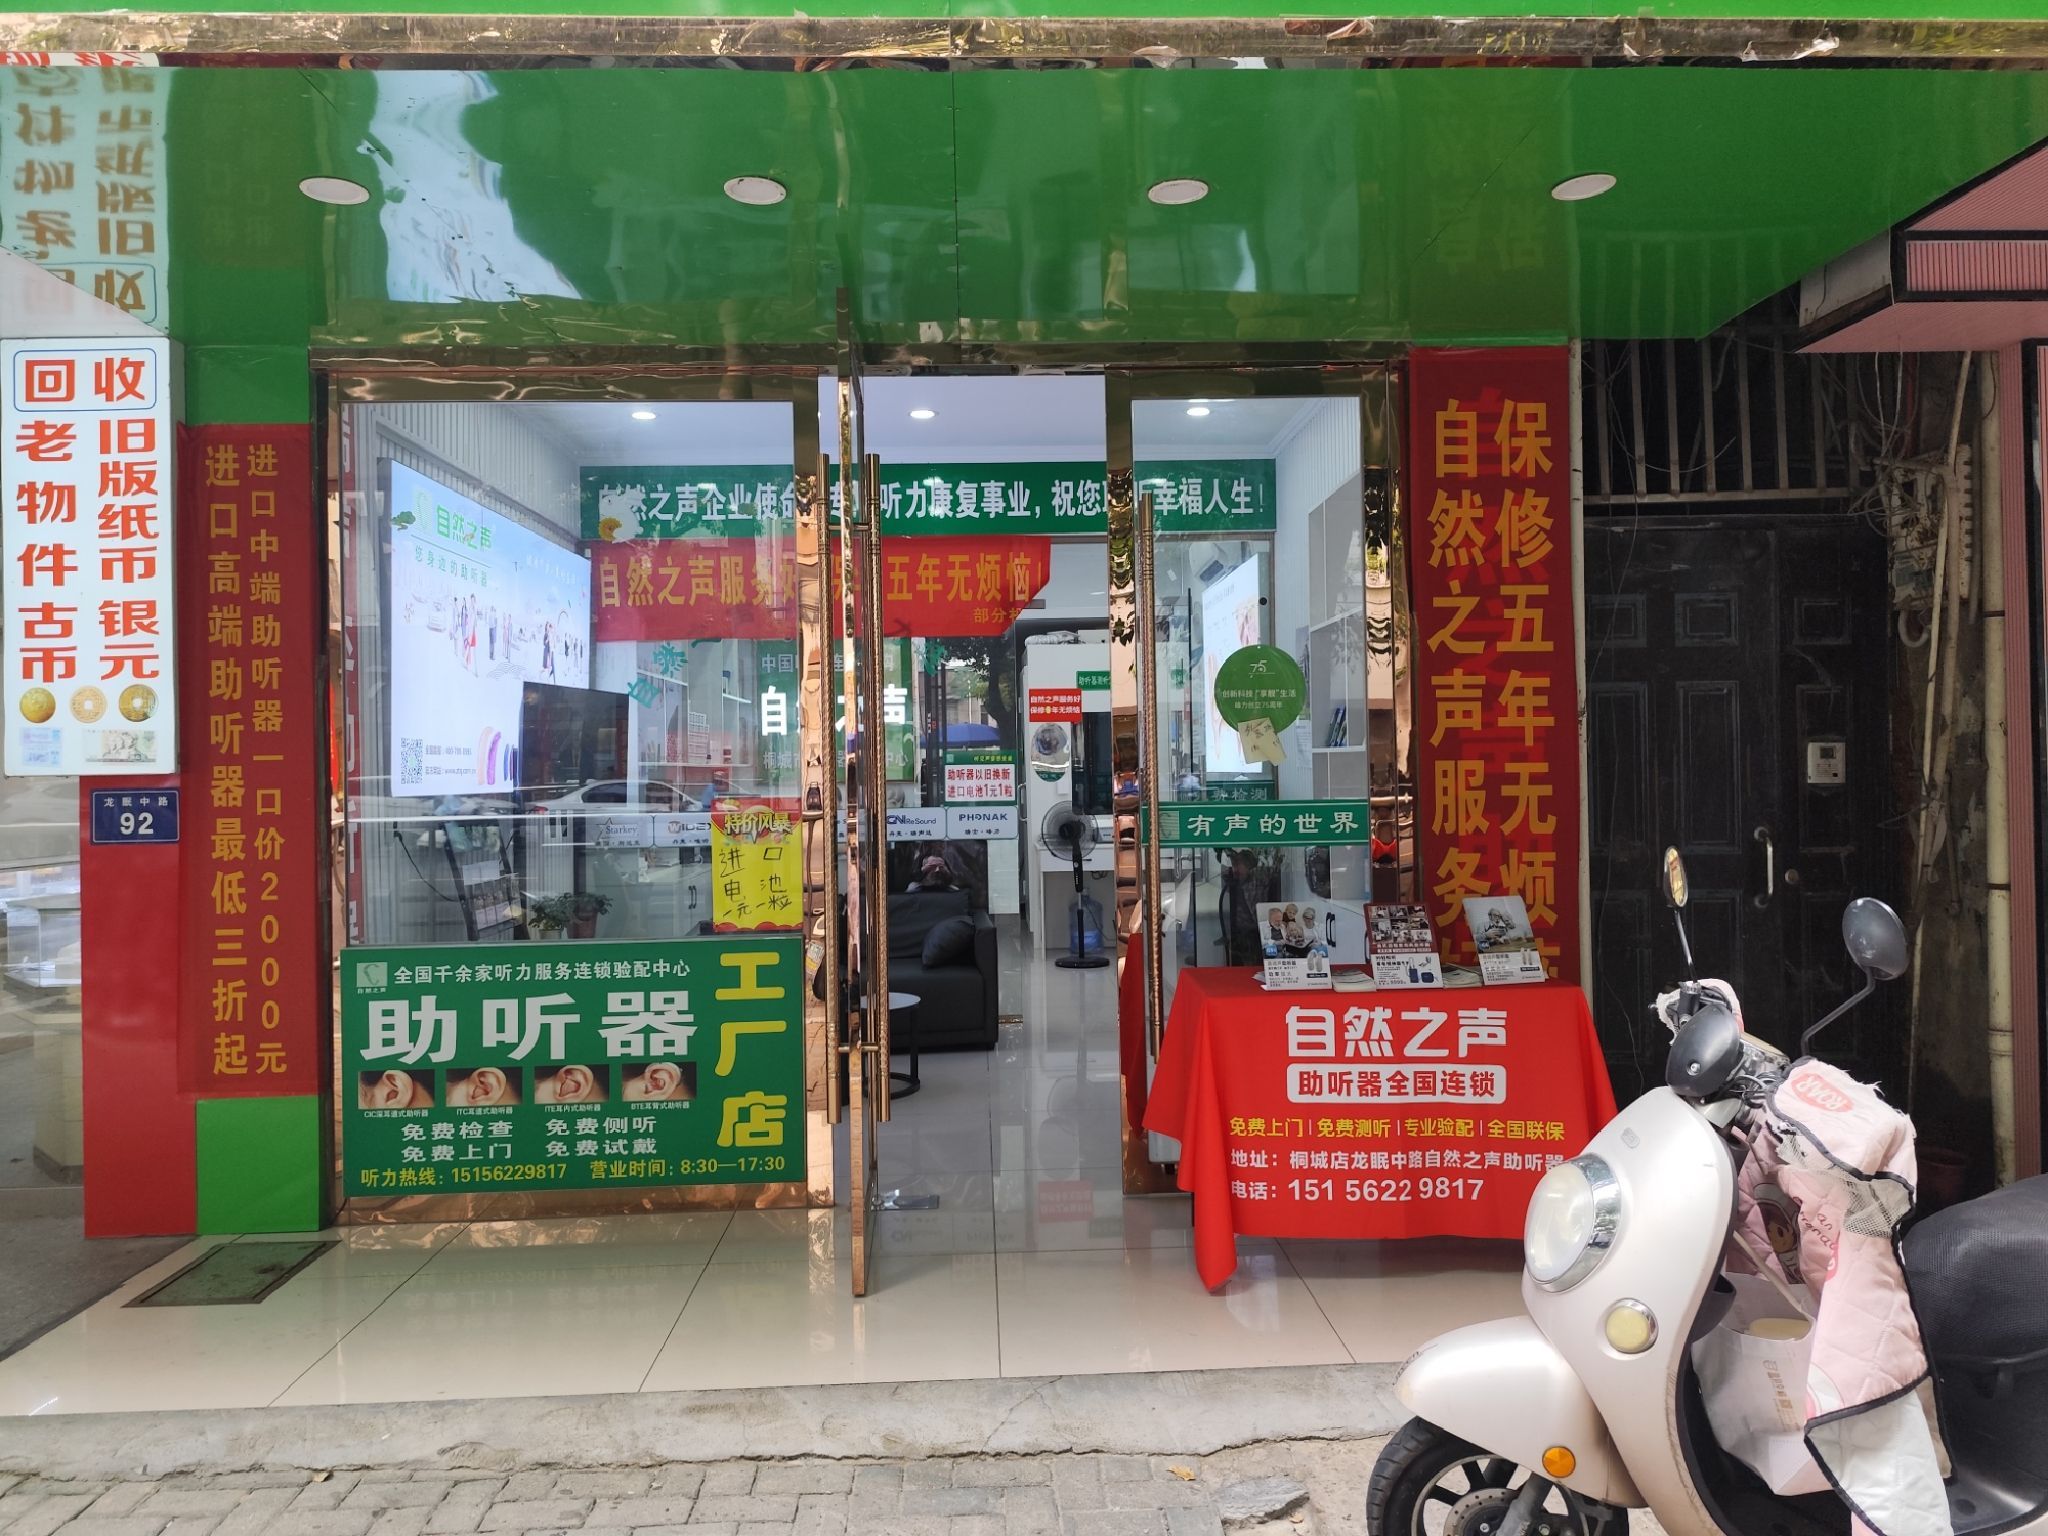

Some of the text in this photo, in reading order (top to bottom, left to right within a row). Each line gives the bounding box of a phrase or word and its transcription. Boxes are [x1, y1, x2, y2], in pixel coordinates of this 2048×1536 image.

[206, 444, 248, 1075] 进口高端助听器最低三折起
[247, 444, 287, 1075] 进口中端助听器一口价2000元
[103, 796, 169, 808] 龙眠中路
[119, 812, 154, 836] 92
[1187, 812, 1359, 837] 有声的世界
[393, 958, 691, 984] 全国千余家听力服务连锁验配中心
[359, 990, 698, 1065] 助听器
[1286, 1005, 1507, 1058] 自然之声
[714, 951, 788, 1149] 工厂店
[1298, 1069, 1495, 1098] 助听器全国连锁
[401, 1121, 513, 1141] 免费检查
[1229, 1117, 1565, 1140] 免费上门 免费测听 专业验配 全国联保
[402, 1138, 657, 1163] 免费上门 免费试戴
[452, 1163, 567, 1183] 15156229817
